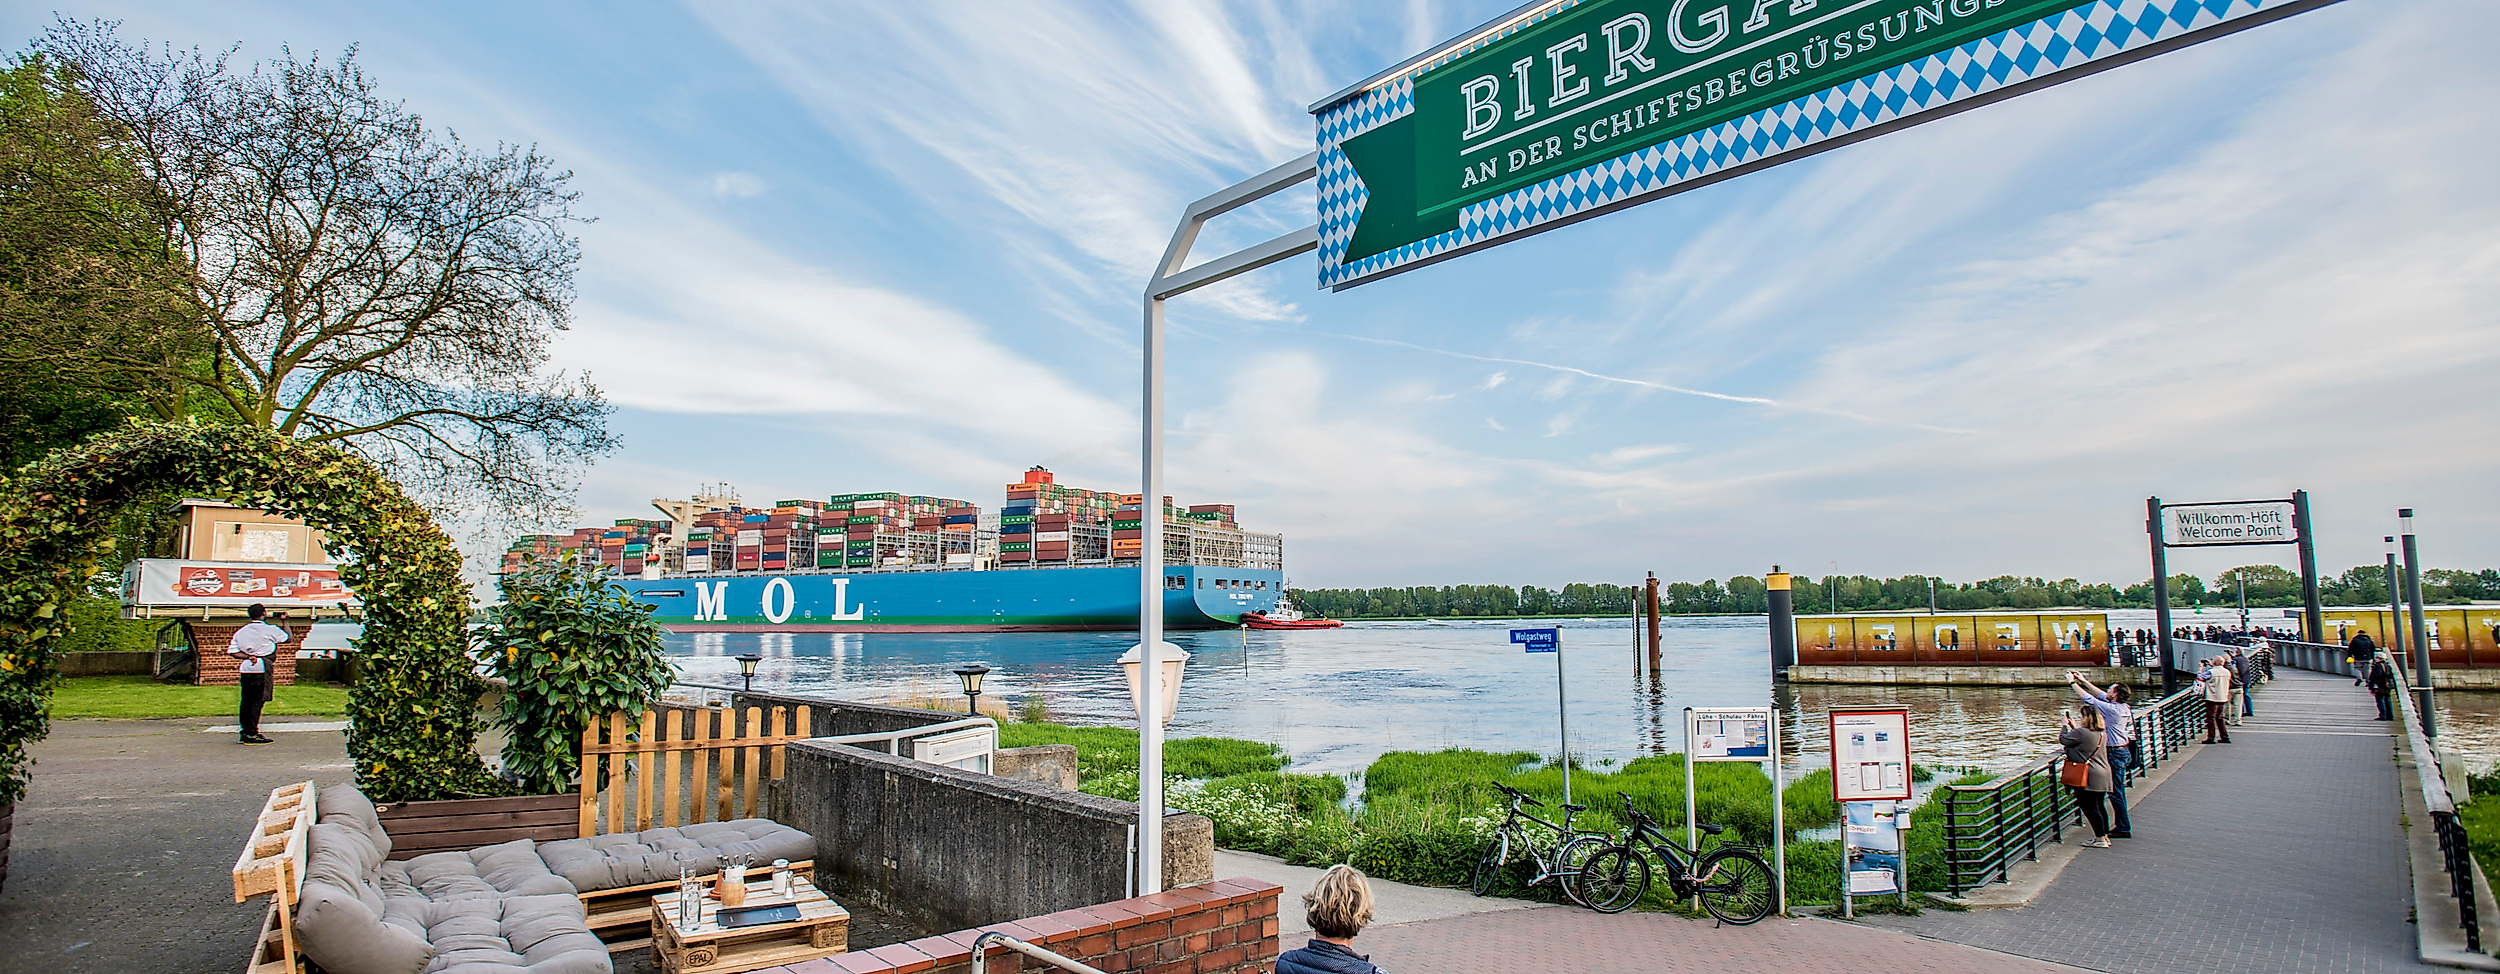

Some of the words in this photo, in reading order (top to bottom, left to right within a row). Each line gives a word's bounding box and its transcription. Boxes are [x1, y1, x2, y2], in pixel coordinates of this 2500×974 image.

[1461, 157, 1498, 189] AN
[1508, 135, 1562, 173] DER
[1573, 0, 2006, 150] SCHIFFSBEGRÜSSUNG
[2178, 510, 2282, 525] Willkomm-Höft
[2180, 525, 2242, 538] Welcome
[2247, 525, 2282, 537] Point
[693, 577, 864, 624] MOL
[1515, 632, 1552, 643] Wolgastweg
[689, 953, 709, 965] EPAL
